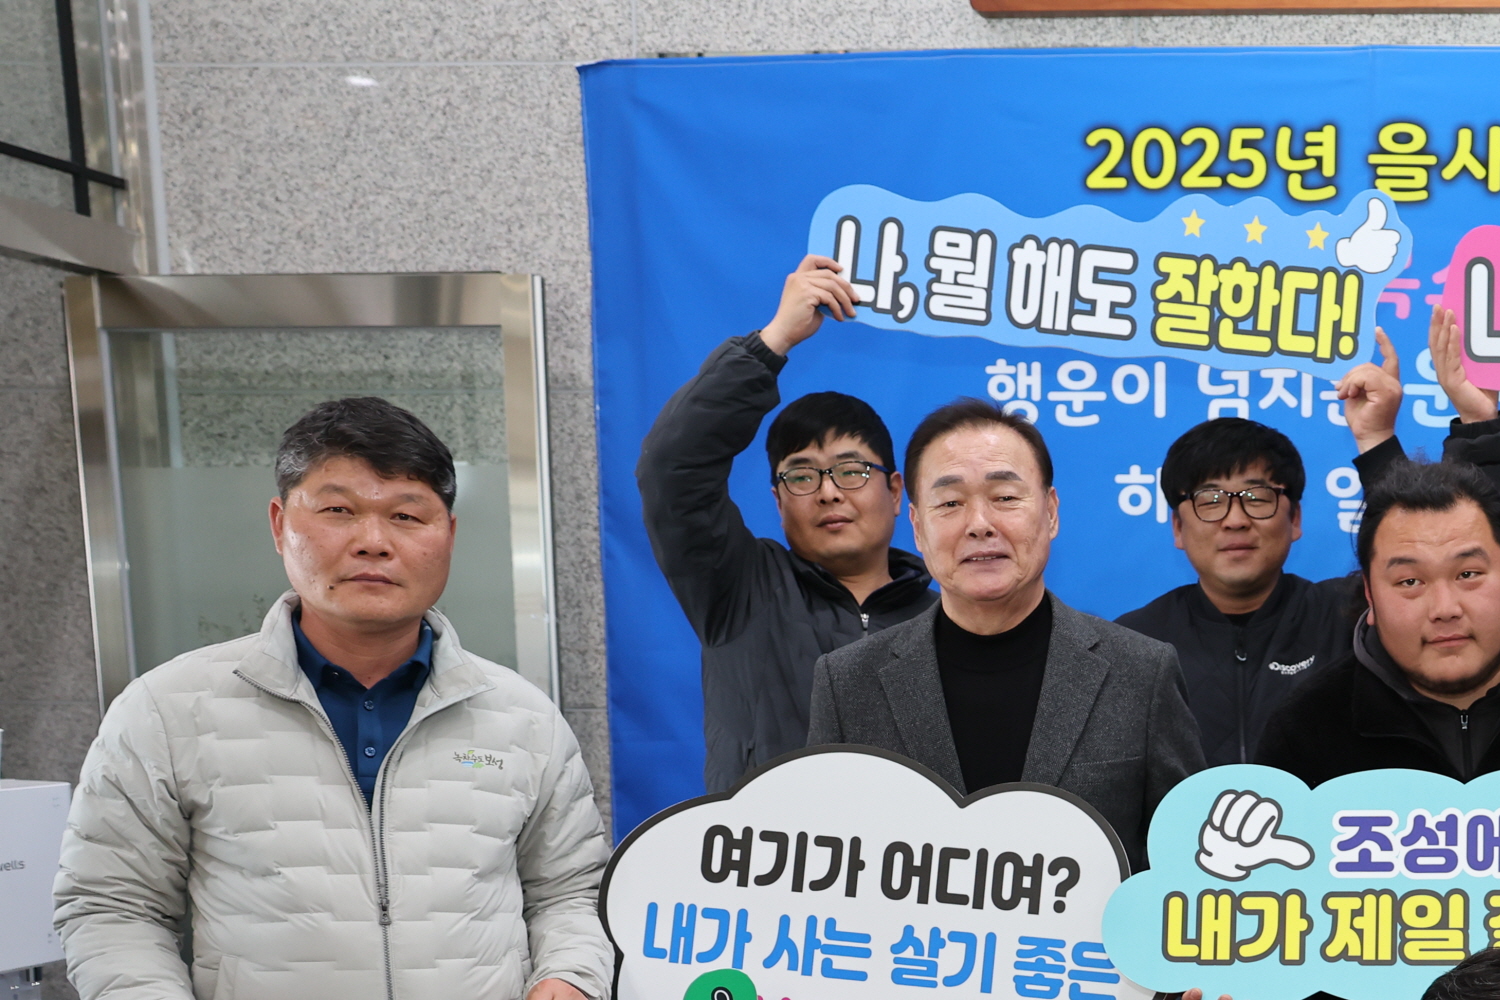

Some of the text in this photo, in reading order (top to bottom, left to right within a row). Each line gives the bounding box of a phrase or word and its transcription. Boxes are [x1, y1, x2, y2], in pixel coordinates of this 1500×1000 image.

[1083, 123, 1338, 203] 2025년
[833, 216, 914, 321] 나,
[925, 226, 997, 325] 뭘
[1005, 236, 1138, 341] 해도
[1152, 252, 1364, 363] 잘한다!
[985, 358, 1167, 427] 행운이
[701, 824, 1081, 914] 여기가 어디여?
[642, 902, 752, 969] 내가
[762, 914, 872, 981] 사는
[890, 924, 997, 993] 살기
[1163, 890, 1312, 964] 내가
[1323, 890, 1467, 963] 제일
